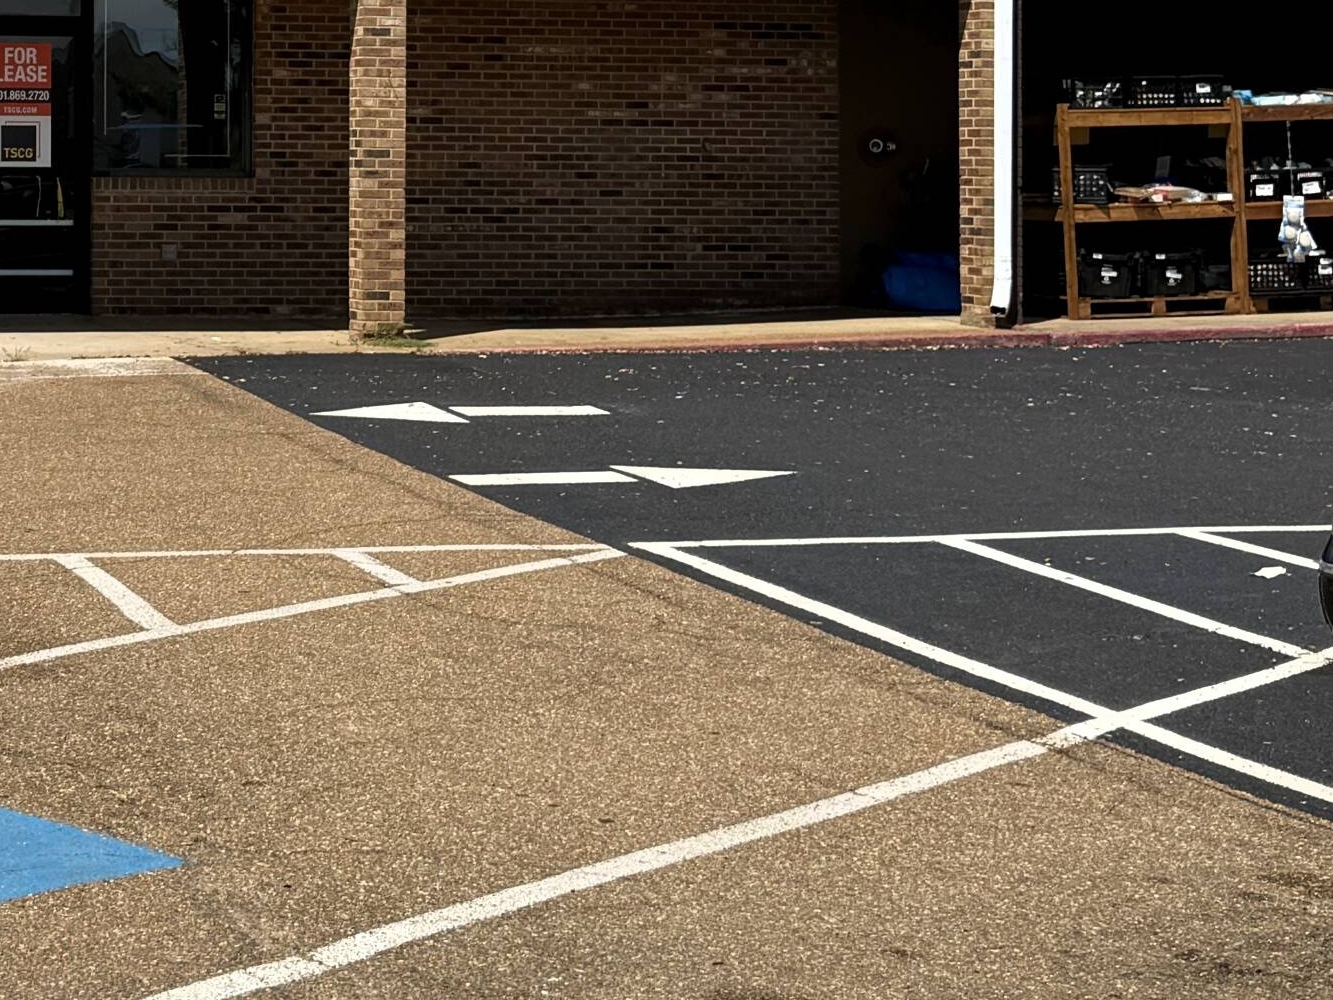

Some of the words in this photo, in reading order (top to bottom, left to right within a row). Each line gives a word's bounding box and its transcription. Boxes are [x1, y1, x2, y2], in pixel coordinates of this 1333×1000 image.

[4, 47, 37, 64] FOR
[3, 106, 38, 114] TSCG.COM
[4, 147, 34, 159] TSCG
